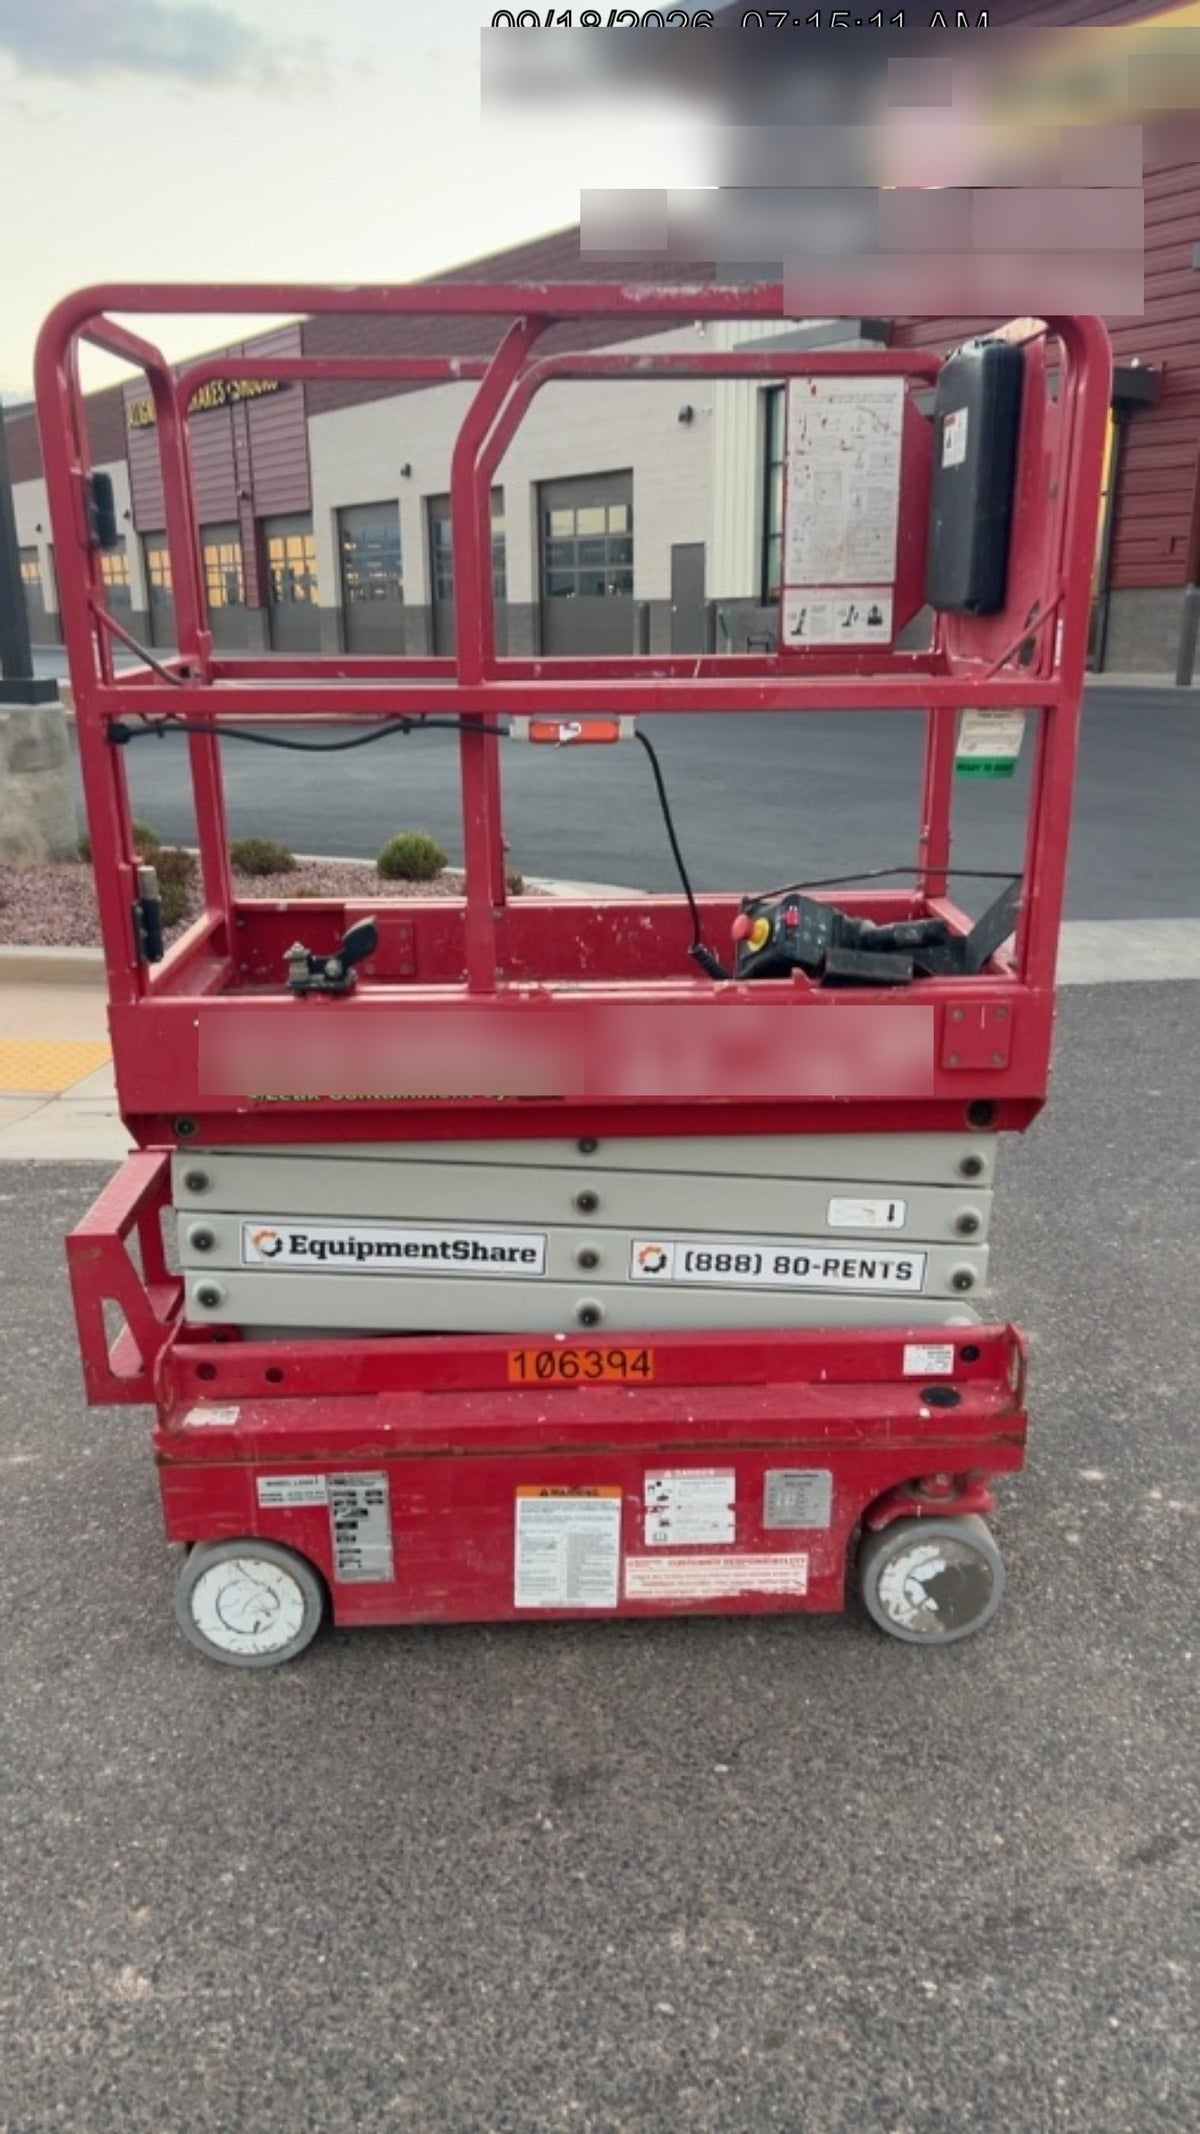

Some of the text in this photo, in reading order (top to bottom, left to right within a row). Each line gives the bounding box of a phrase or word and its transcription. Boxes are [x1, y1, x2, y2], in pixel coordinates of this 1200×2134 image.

[289, 1234, 537, 1263] EquipmentShare
[684, 1251, 913, 1281] (888) 80-RENTS
[513, 1350, 650, 1379] 106394
